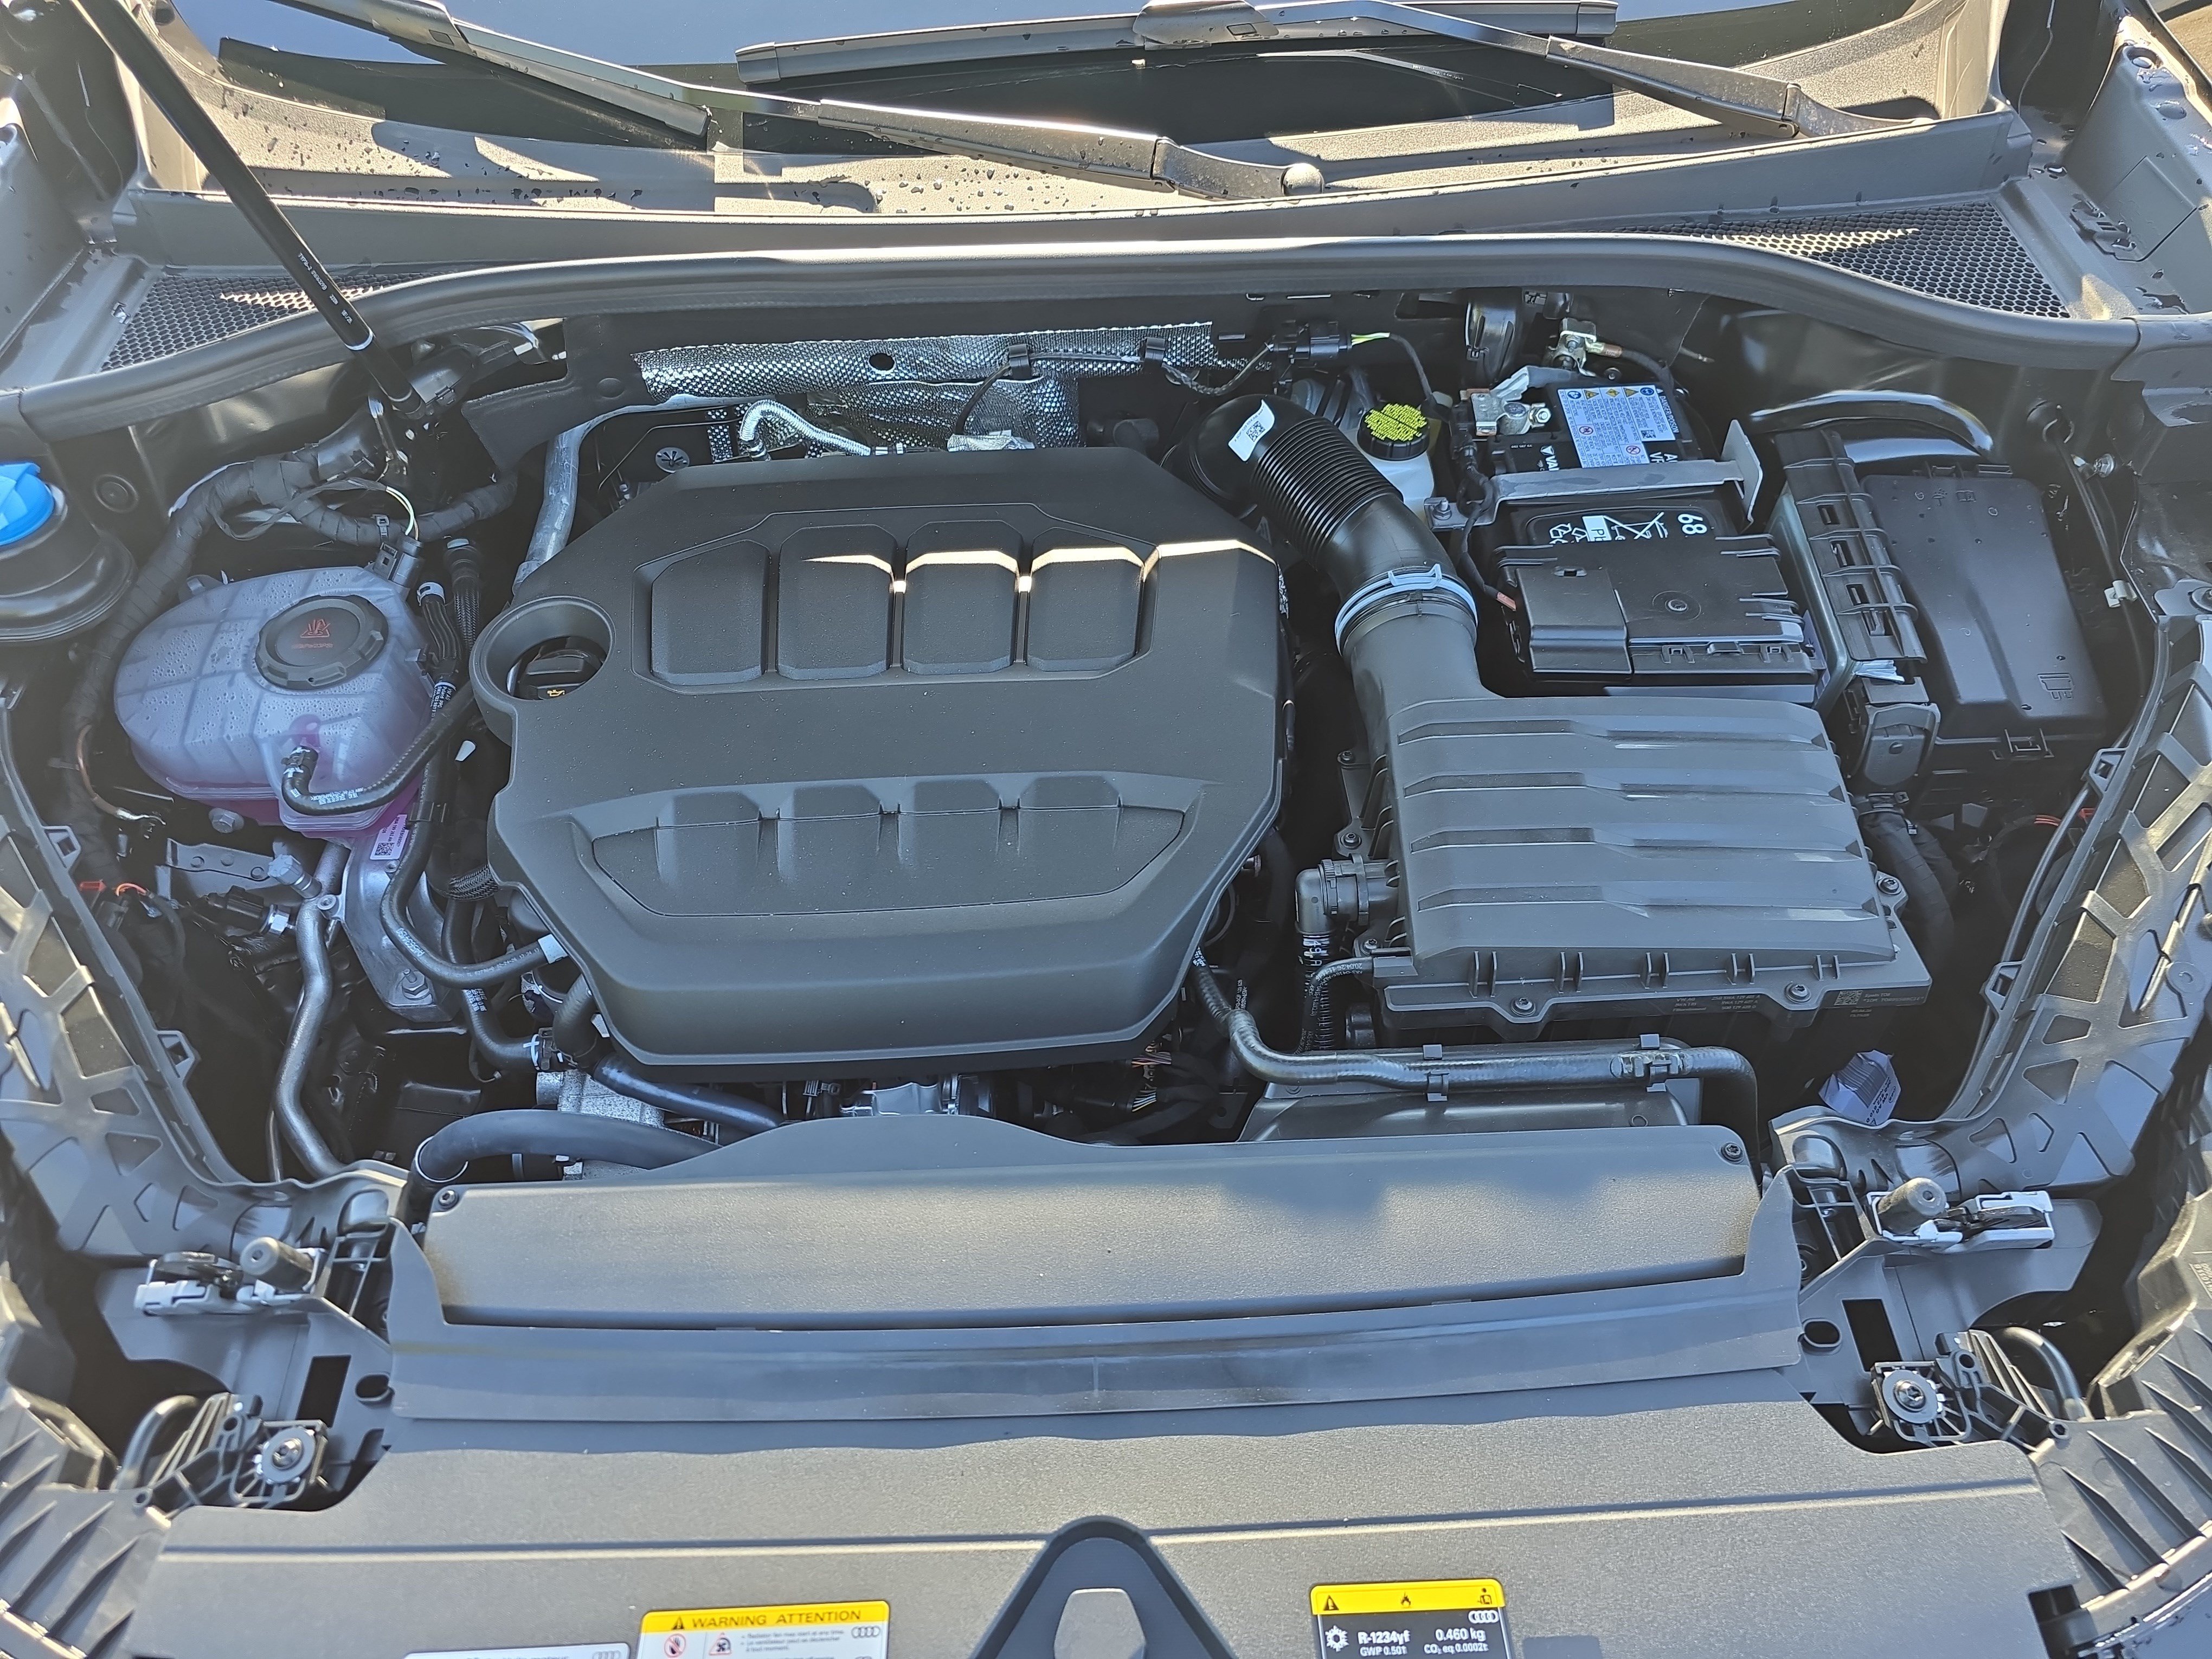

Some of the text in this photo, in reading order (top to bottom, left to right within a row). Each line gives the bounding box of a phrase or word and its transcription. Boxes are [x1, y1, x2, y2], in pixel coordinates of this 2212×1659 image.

[1659, 395, 1679, 433] DANGER/POISON
[1678, 514, 1707, 535] 68
[691, 1610, 861, 1628] WARNING ATTENTION
[1358, 1628, 1486, 1645] R-1234yf 0.460 kg
[1360, 1647, 1382, 1657] GWP
[1442, 1645, 1455, 1654] eq
